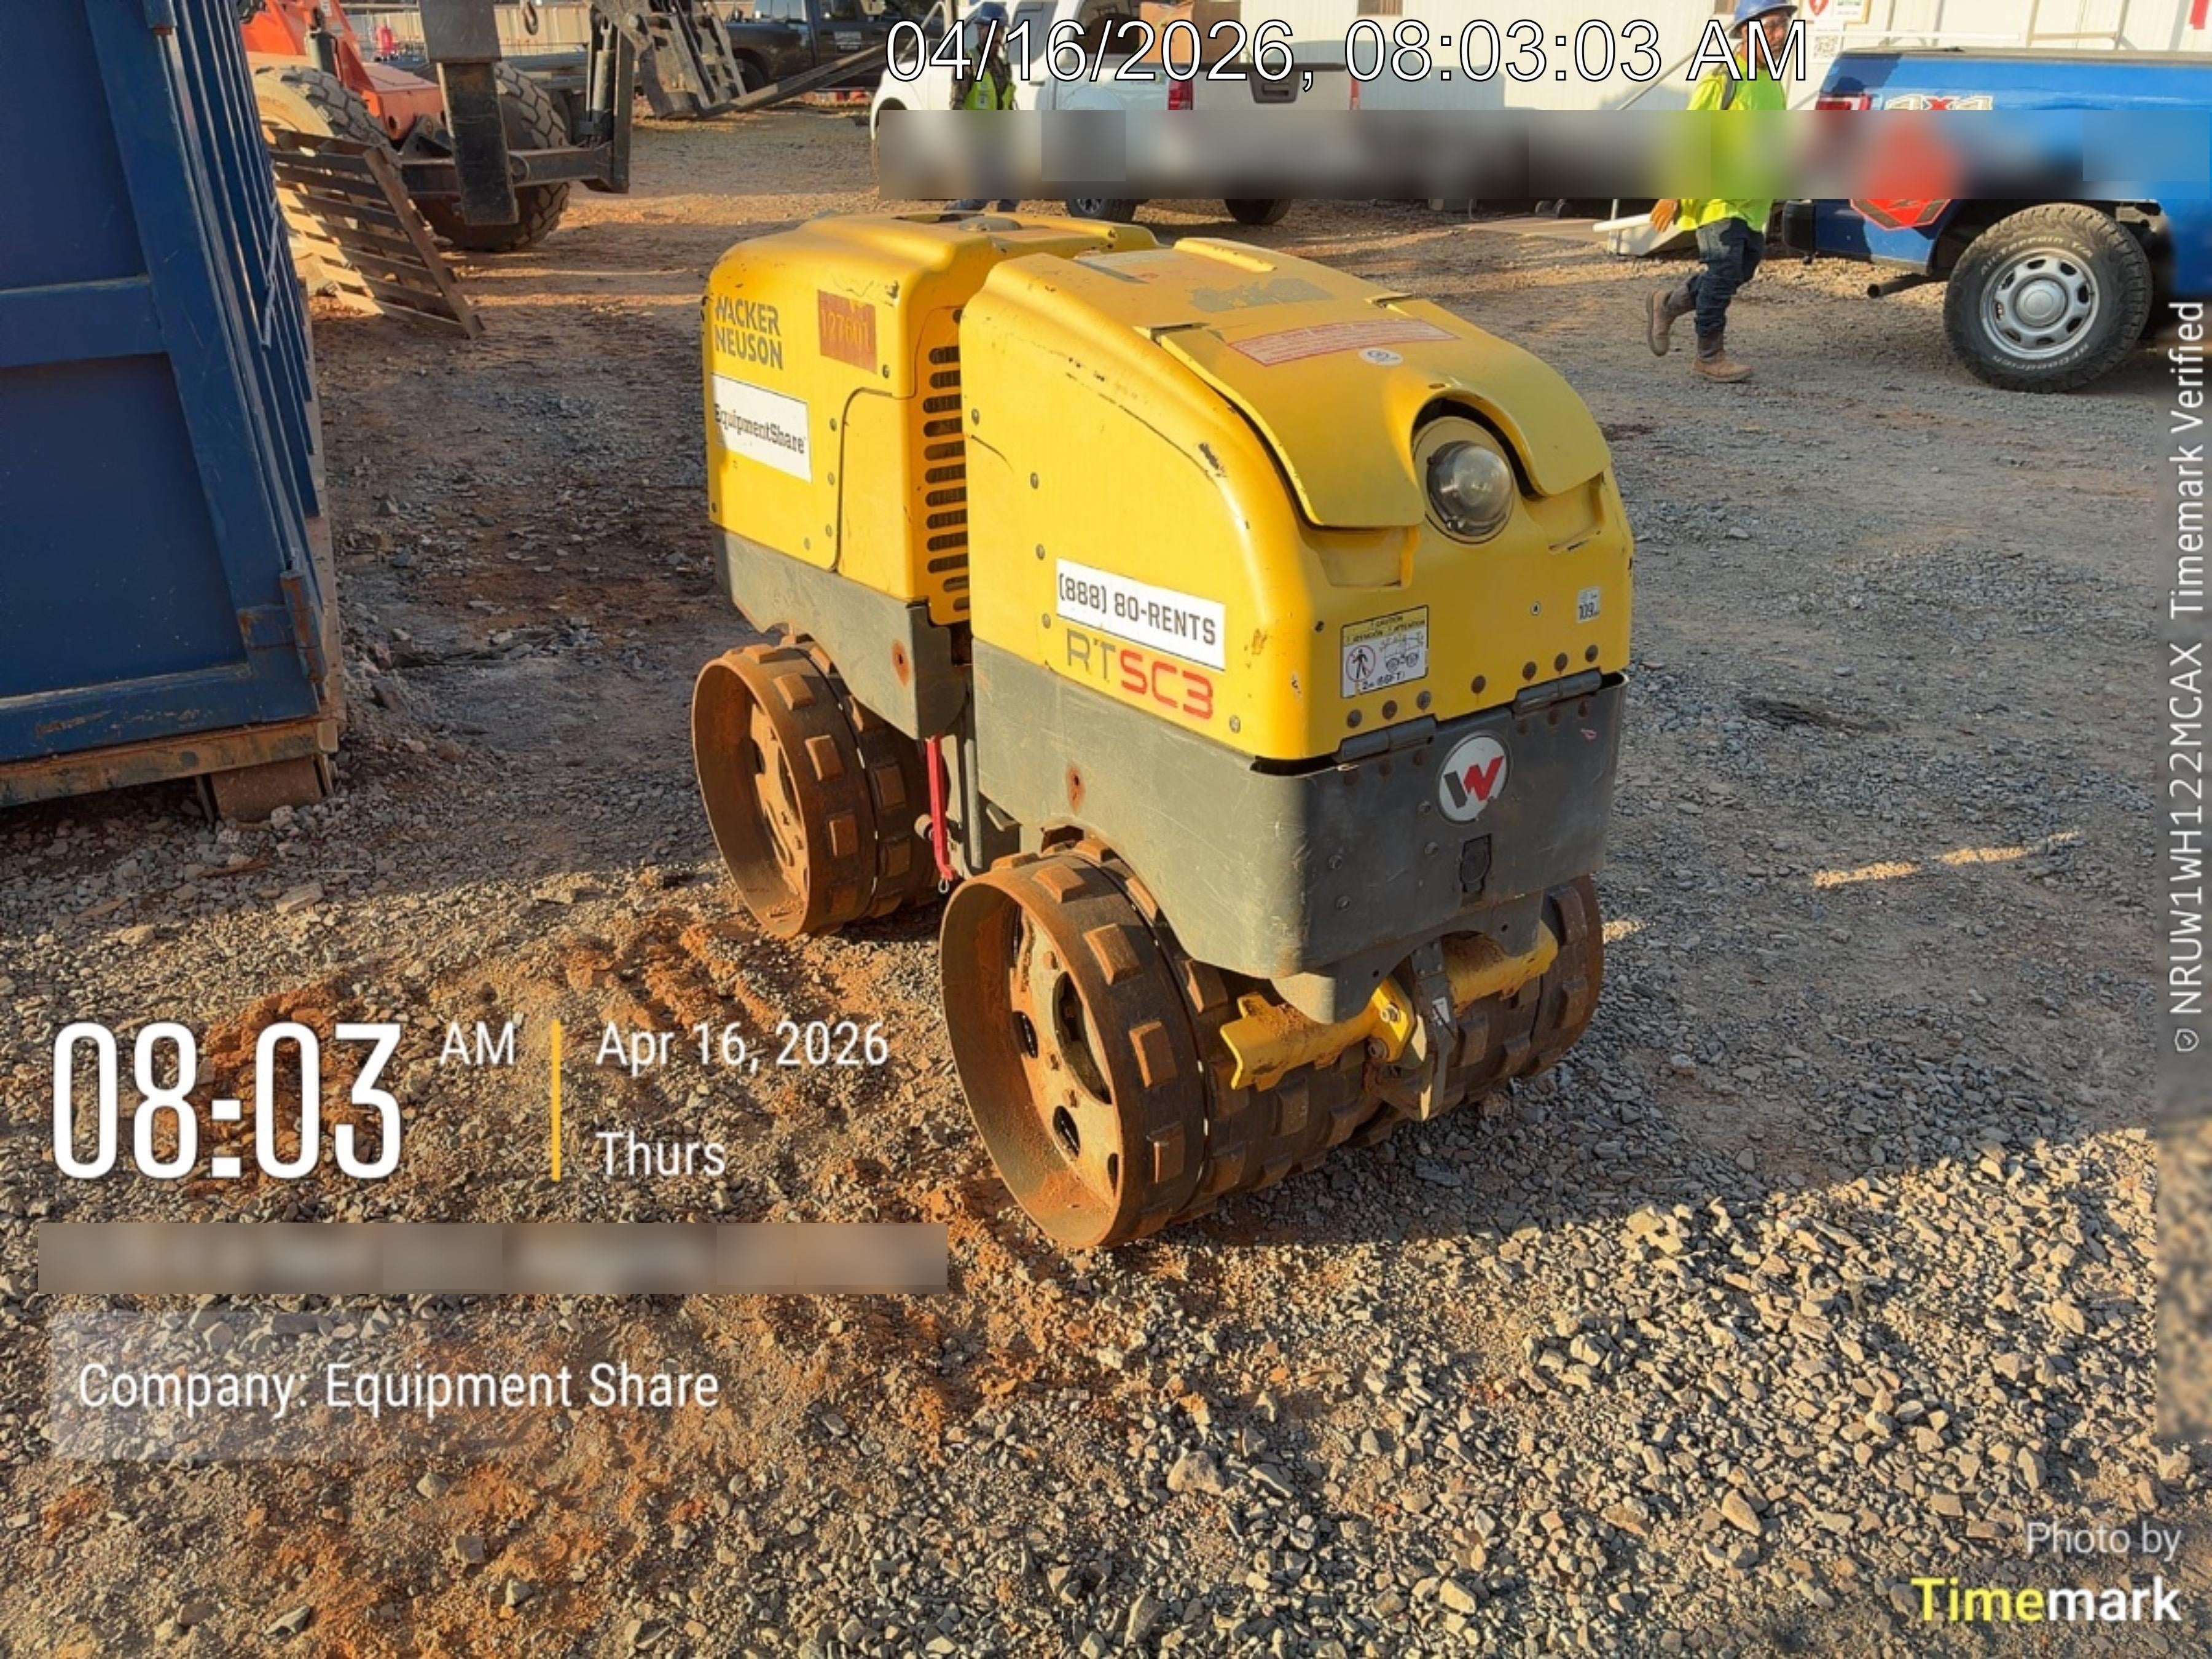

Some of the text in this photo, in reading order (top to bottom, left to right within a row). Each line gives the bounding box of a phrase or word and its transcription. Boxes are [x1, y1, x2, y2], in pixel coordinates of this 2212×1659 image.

[715, 296, 781, 337] WACKER
[714, 324, 783, 371] NEUSON
[714, 402, 805, 454] EquipmentShare
[1059, 573, 1217, 646] (888) 80-RENTS
[1065, 627, 1214, 720] RTSC3
